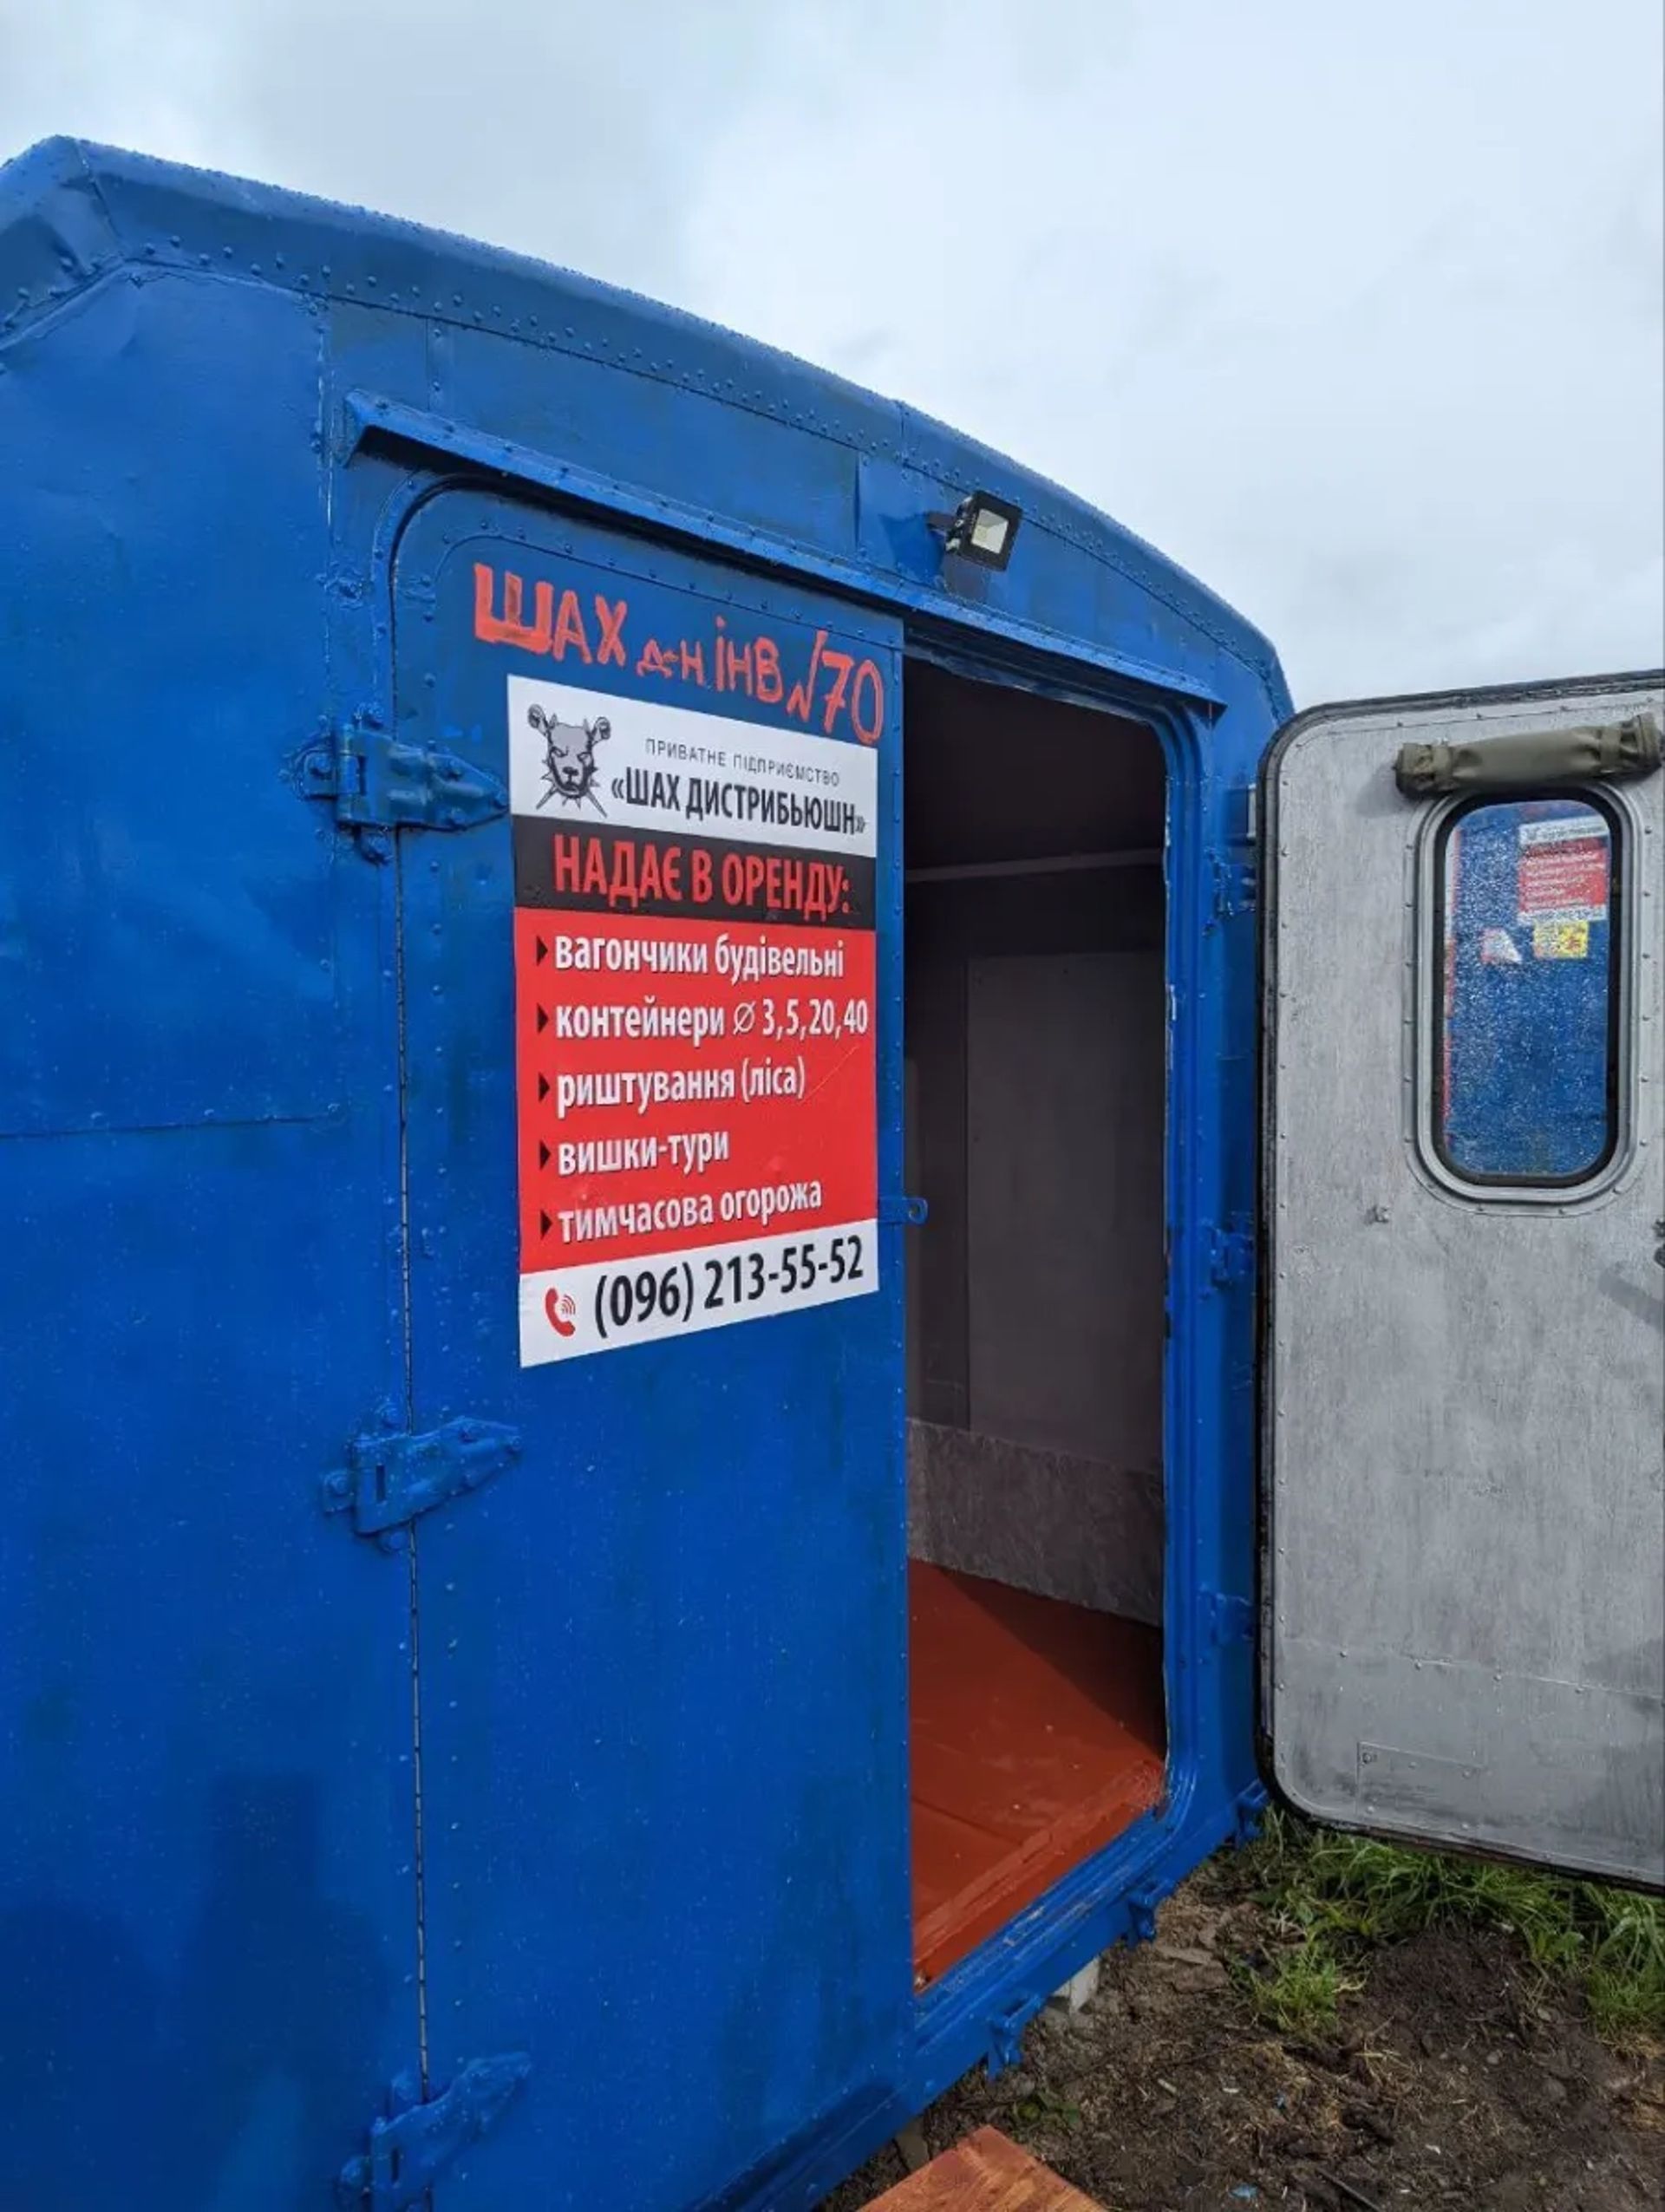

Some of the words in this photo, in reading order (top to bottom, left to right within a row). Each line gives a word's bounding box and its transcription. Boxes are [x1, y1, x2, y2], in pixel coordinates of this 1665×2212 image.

[473, 563, 628, 666] ШАХ
[646, 738, 726, 767] ПРИВАТНЕ
[734, 754, 839, 786] ПІДПРИЄМСТВО
[611, 767, 680, 811] «ШАХ
[685, 777, 866, 835] ДИСТРИБЬЮШН»
[554, 833, 682, 908] НАДАЄ
[692, 849, 714, 904] В
[722, 853, 851, 922] ОРЕНДУ:
[555, 936, 708, 975] вагончики
[715, 932, 844, 985] будівельні
[555, 996, 724, 1047] контейнери
[762, 998, 868, 1042] 3,5,20,40
[557, 1059, 735, 1119] риштування
[741, 1056, 805, 1100] (ліса)
[558, 1131, 729, 1176] вишки-тури
[558, 1193, 714, 1243] тимчасова
[721, 1180, 822, 1226] огорожа
[595, 1262, 693, 1338] (096)
[704, 1234, 864, 1309] 213-55-52
